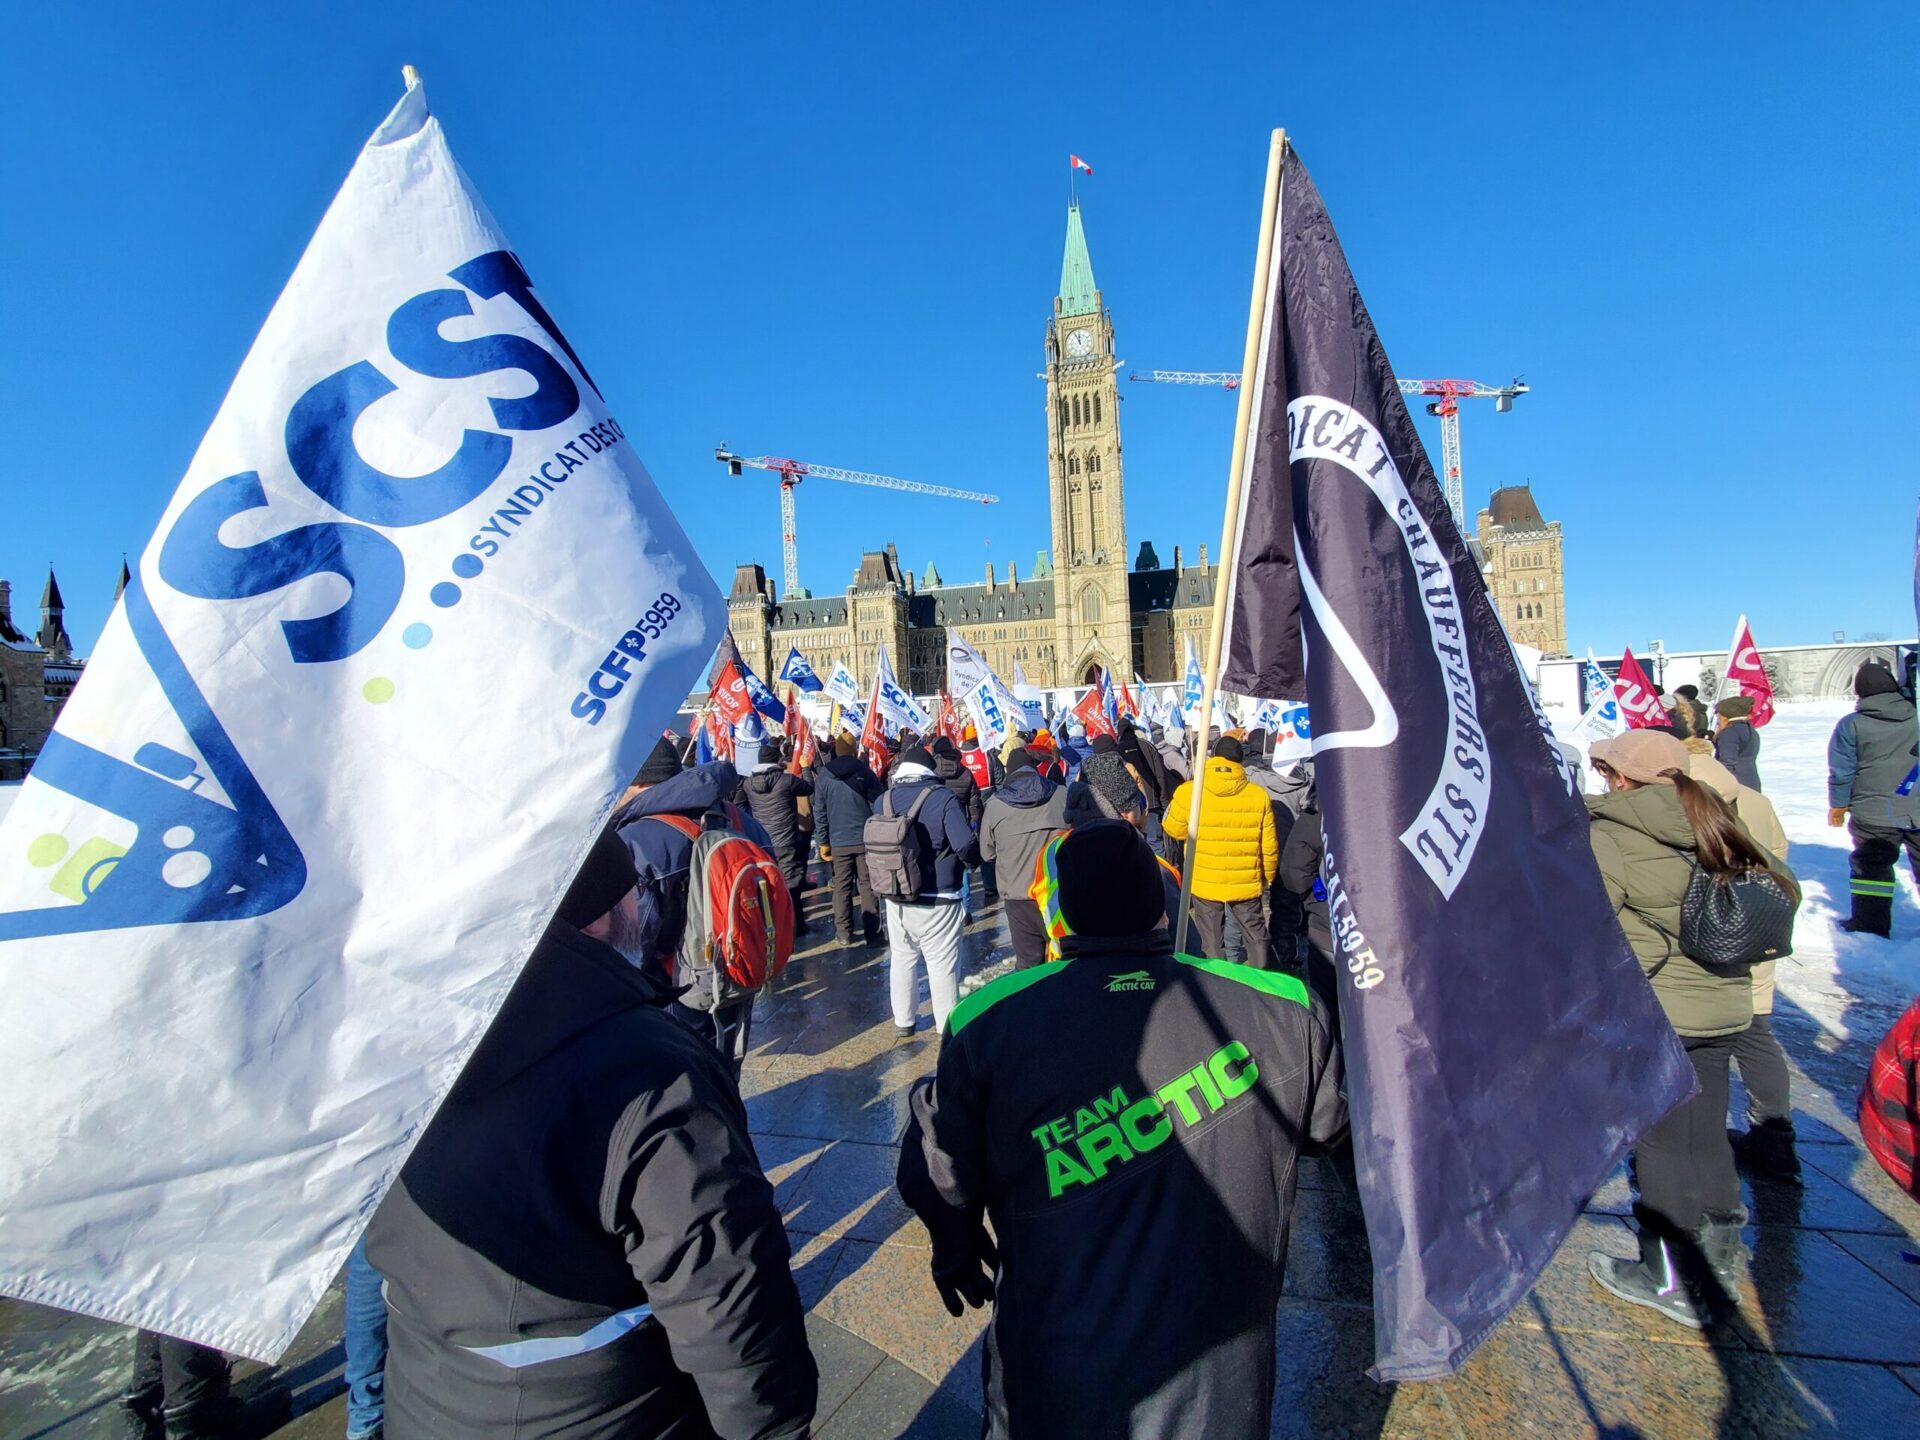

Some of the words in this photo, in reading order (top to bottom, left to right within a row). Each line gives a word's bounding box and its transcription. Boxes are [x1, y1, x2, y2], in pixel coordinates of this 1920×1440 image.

[469, 440, 591, 558] SYNDICAT
[578, 422, 618, 453] DES
[570, 629, 647, 727] SCFP
[635, 592, 682, 640] 5959
[1399, 498, 1486, 784] CHAUFFEURS
[978, 684, 1005, 733] SCFP
[1597, 700, 1617, 721] S
[1417, 782, 1478, 878] STL
[1109, 982, 1139, 992] ARCTIC
[1140, 981, 1156, 990] CAT
[1337, 911, 1386, 990] 5959
[1031, 1085, 1129, 1151] TEAM
[1044, 1039, 1260, 1199] ARCTIC
